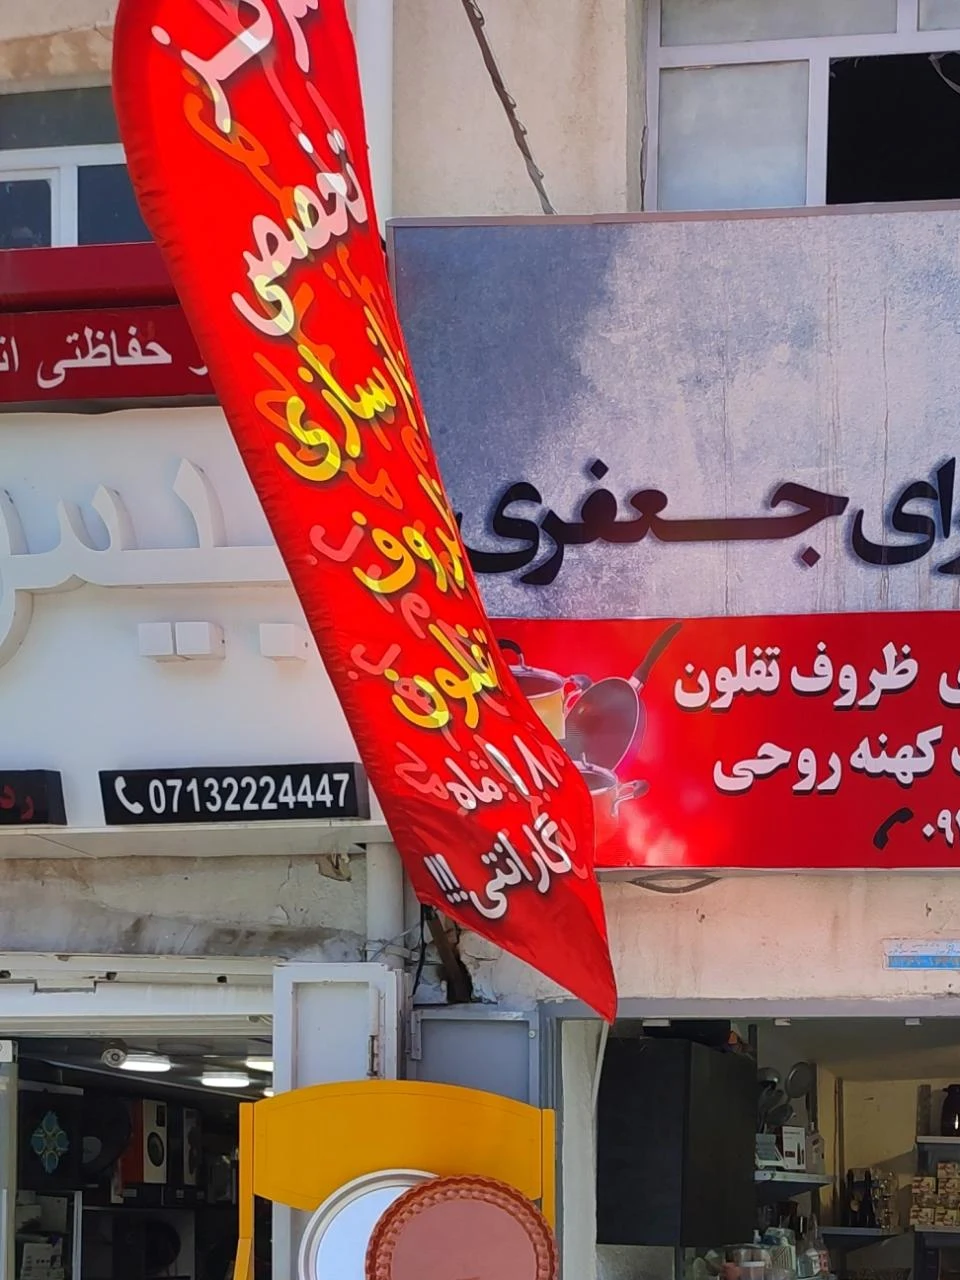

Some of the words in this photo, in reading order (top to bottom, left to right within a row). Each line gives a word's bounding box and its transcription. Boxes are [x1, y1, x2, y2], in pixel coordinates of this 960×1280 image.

[232, 128, 368, 336] تخصصی
[37, 325, 173, 389] حفاظتی
[275, 344, 397, 481] سازی
[458, 457, 851, 586] جعفری
[673, 644, 782, 710] تفلون
[790, 641, 920, 708] ظروف
[445, 757, 504, 811] ماه
[712, 741, 843, 793] روحی
[849, 724, 944, 786] کهنه
[148, 772, 350, 814] 07132224447
